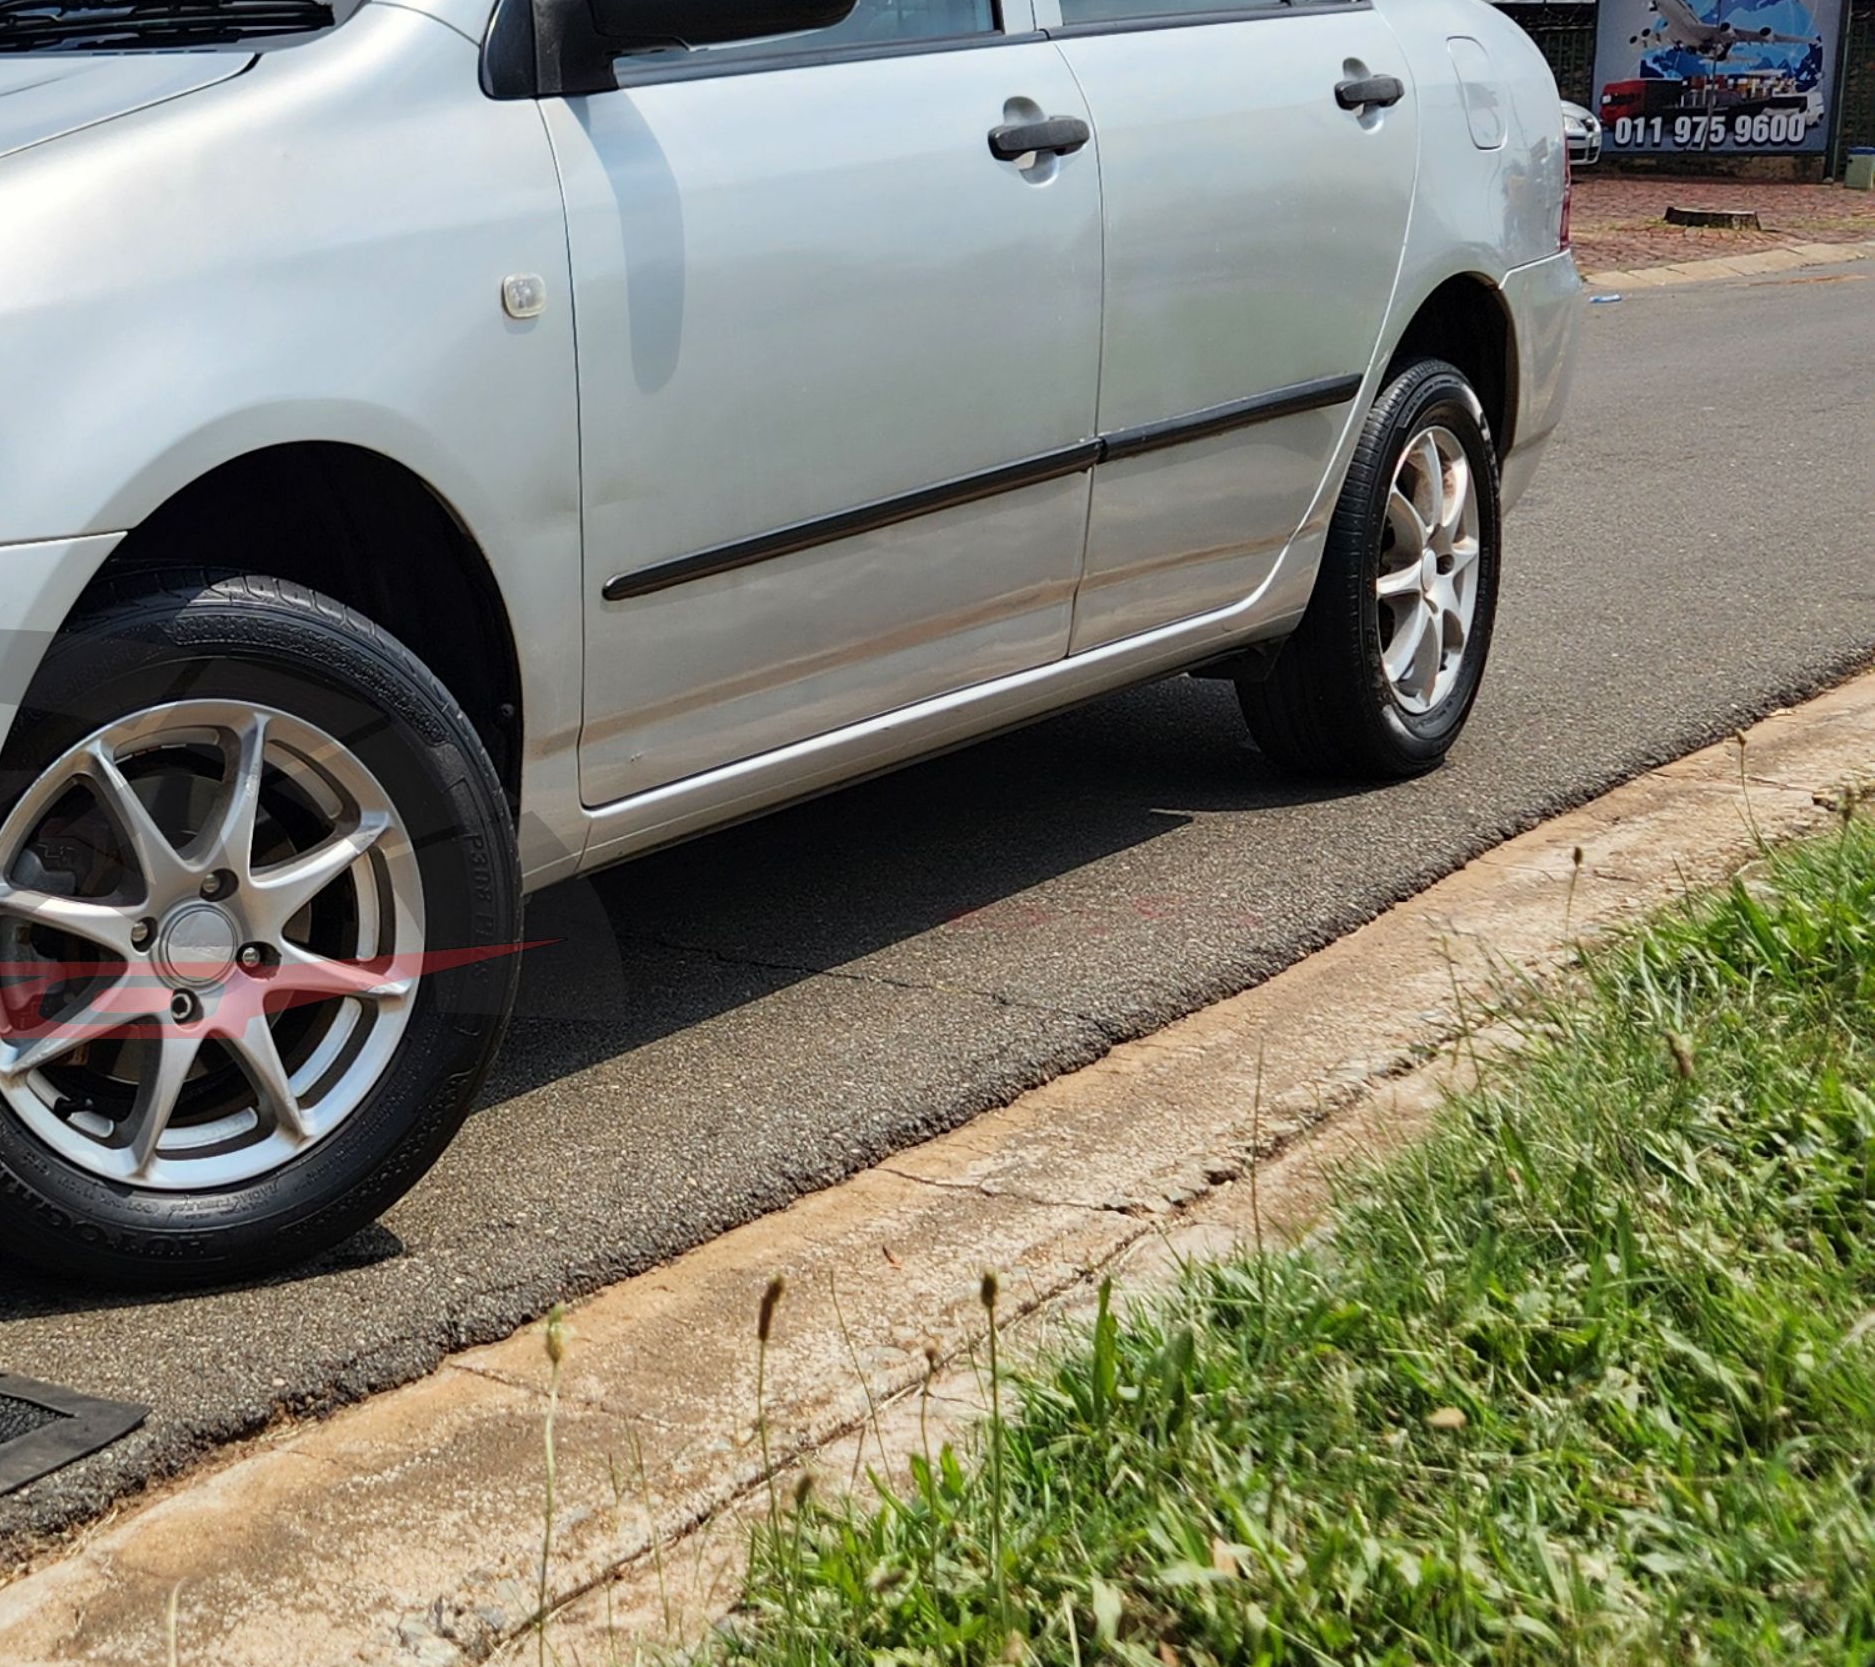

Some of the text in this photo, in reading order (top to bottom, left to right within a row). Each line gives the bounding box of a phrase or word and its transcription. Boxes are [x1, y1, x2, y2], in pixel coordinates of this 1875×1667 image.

[1614, 113, 1807, 146] 011 975 9600
